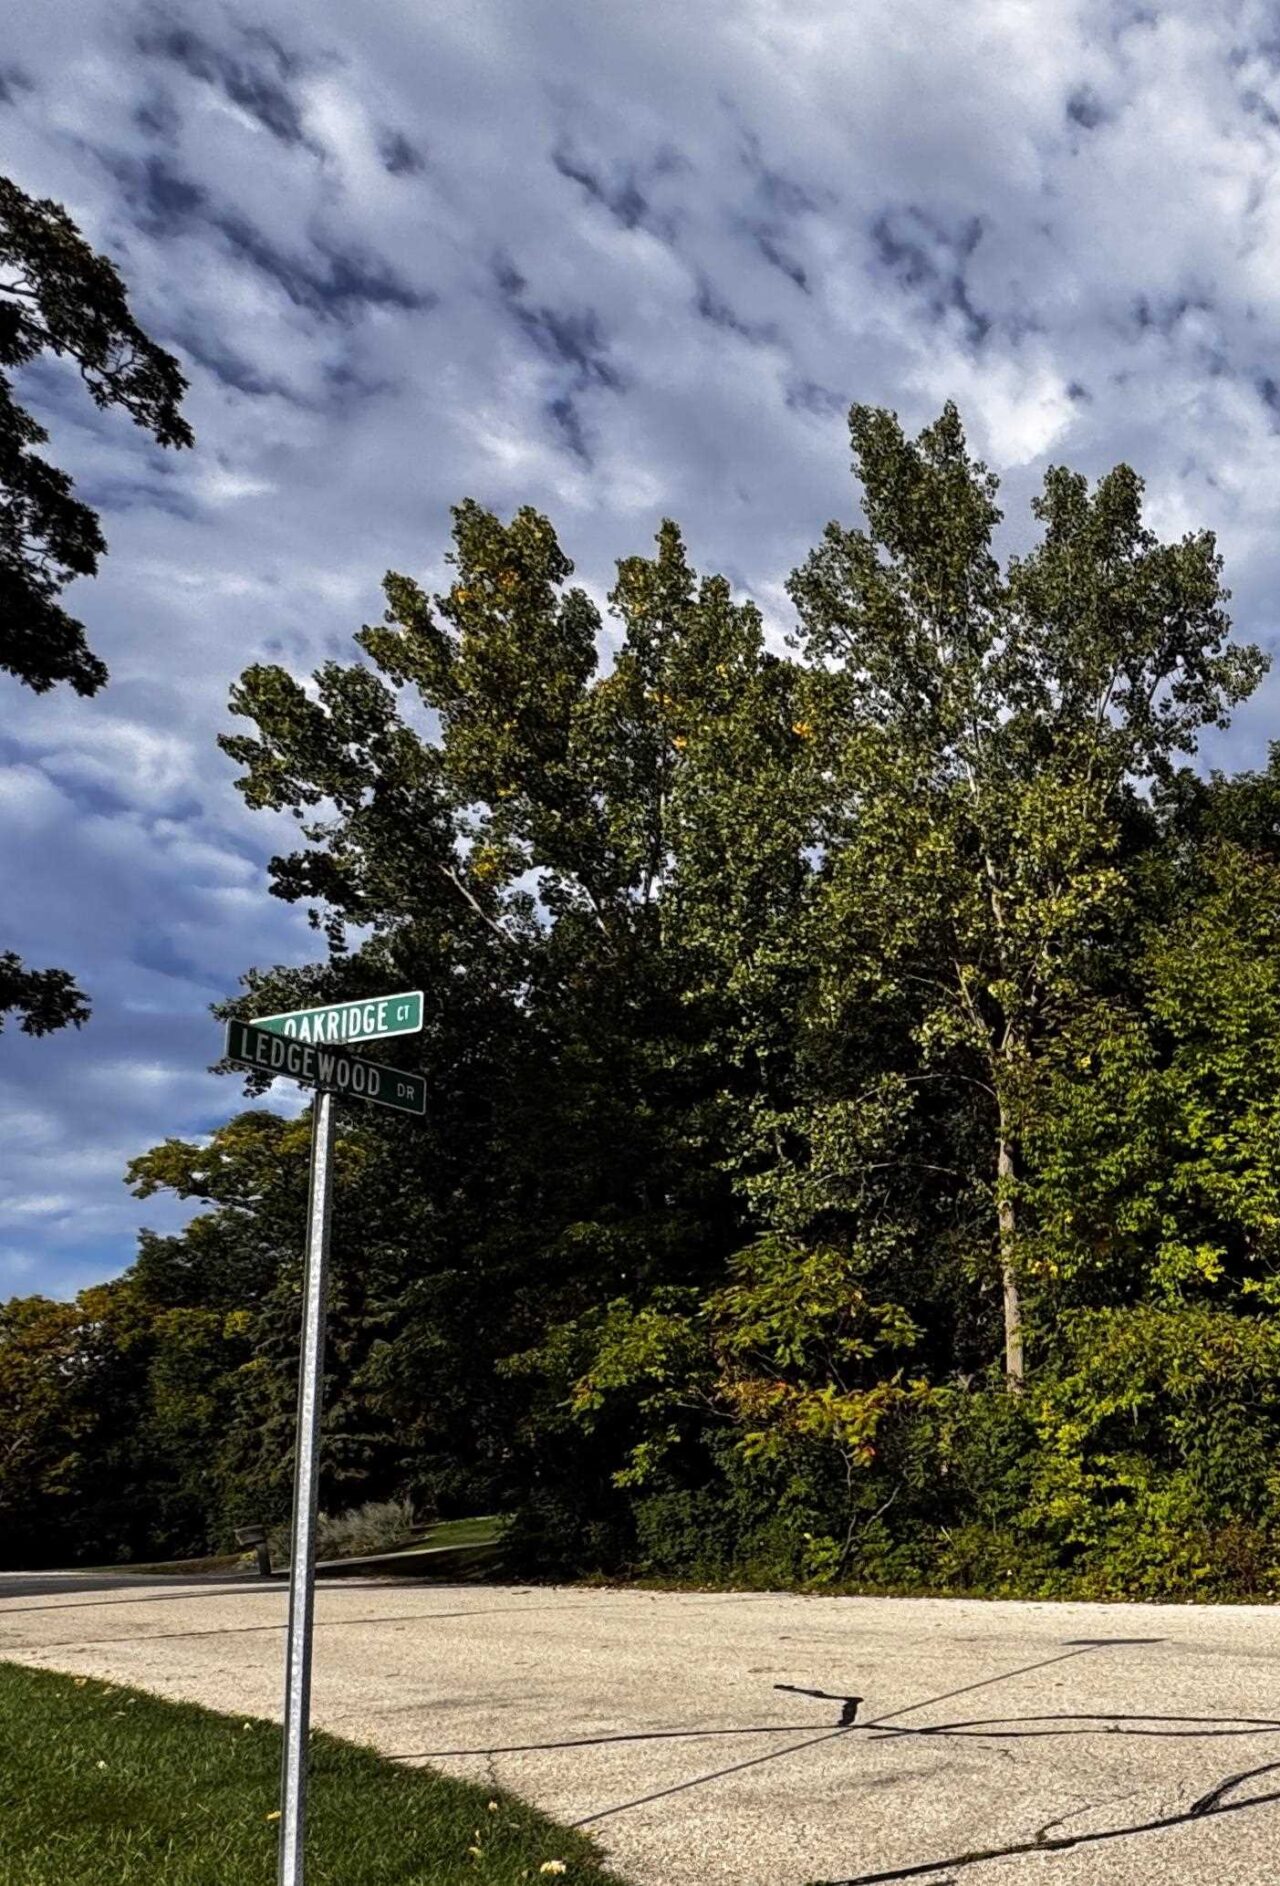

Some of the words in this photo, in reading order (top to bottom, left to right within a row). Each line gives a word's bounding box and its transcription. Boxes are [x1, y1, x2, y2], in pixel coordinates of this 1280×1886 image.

[284, 1002, 389, 1043] OAKRIDGE
[396, 1004, 410, 1021] CT
[240, 1028, 380, 1096] LEDGEWOOD
[397, 1082, 415, 1101] DR
